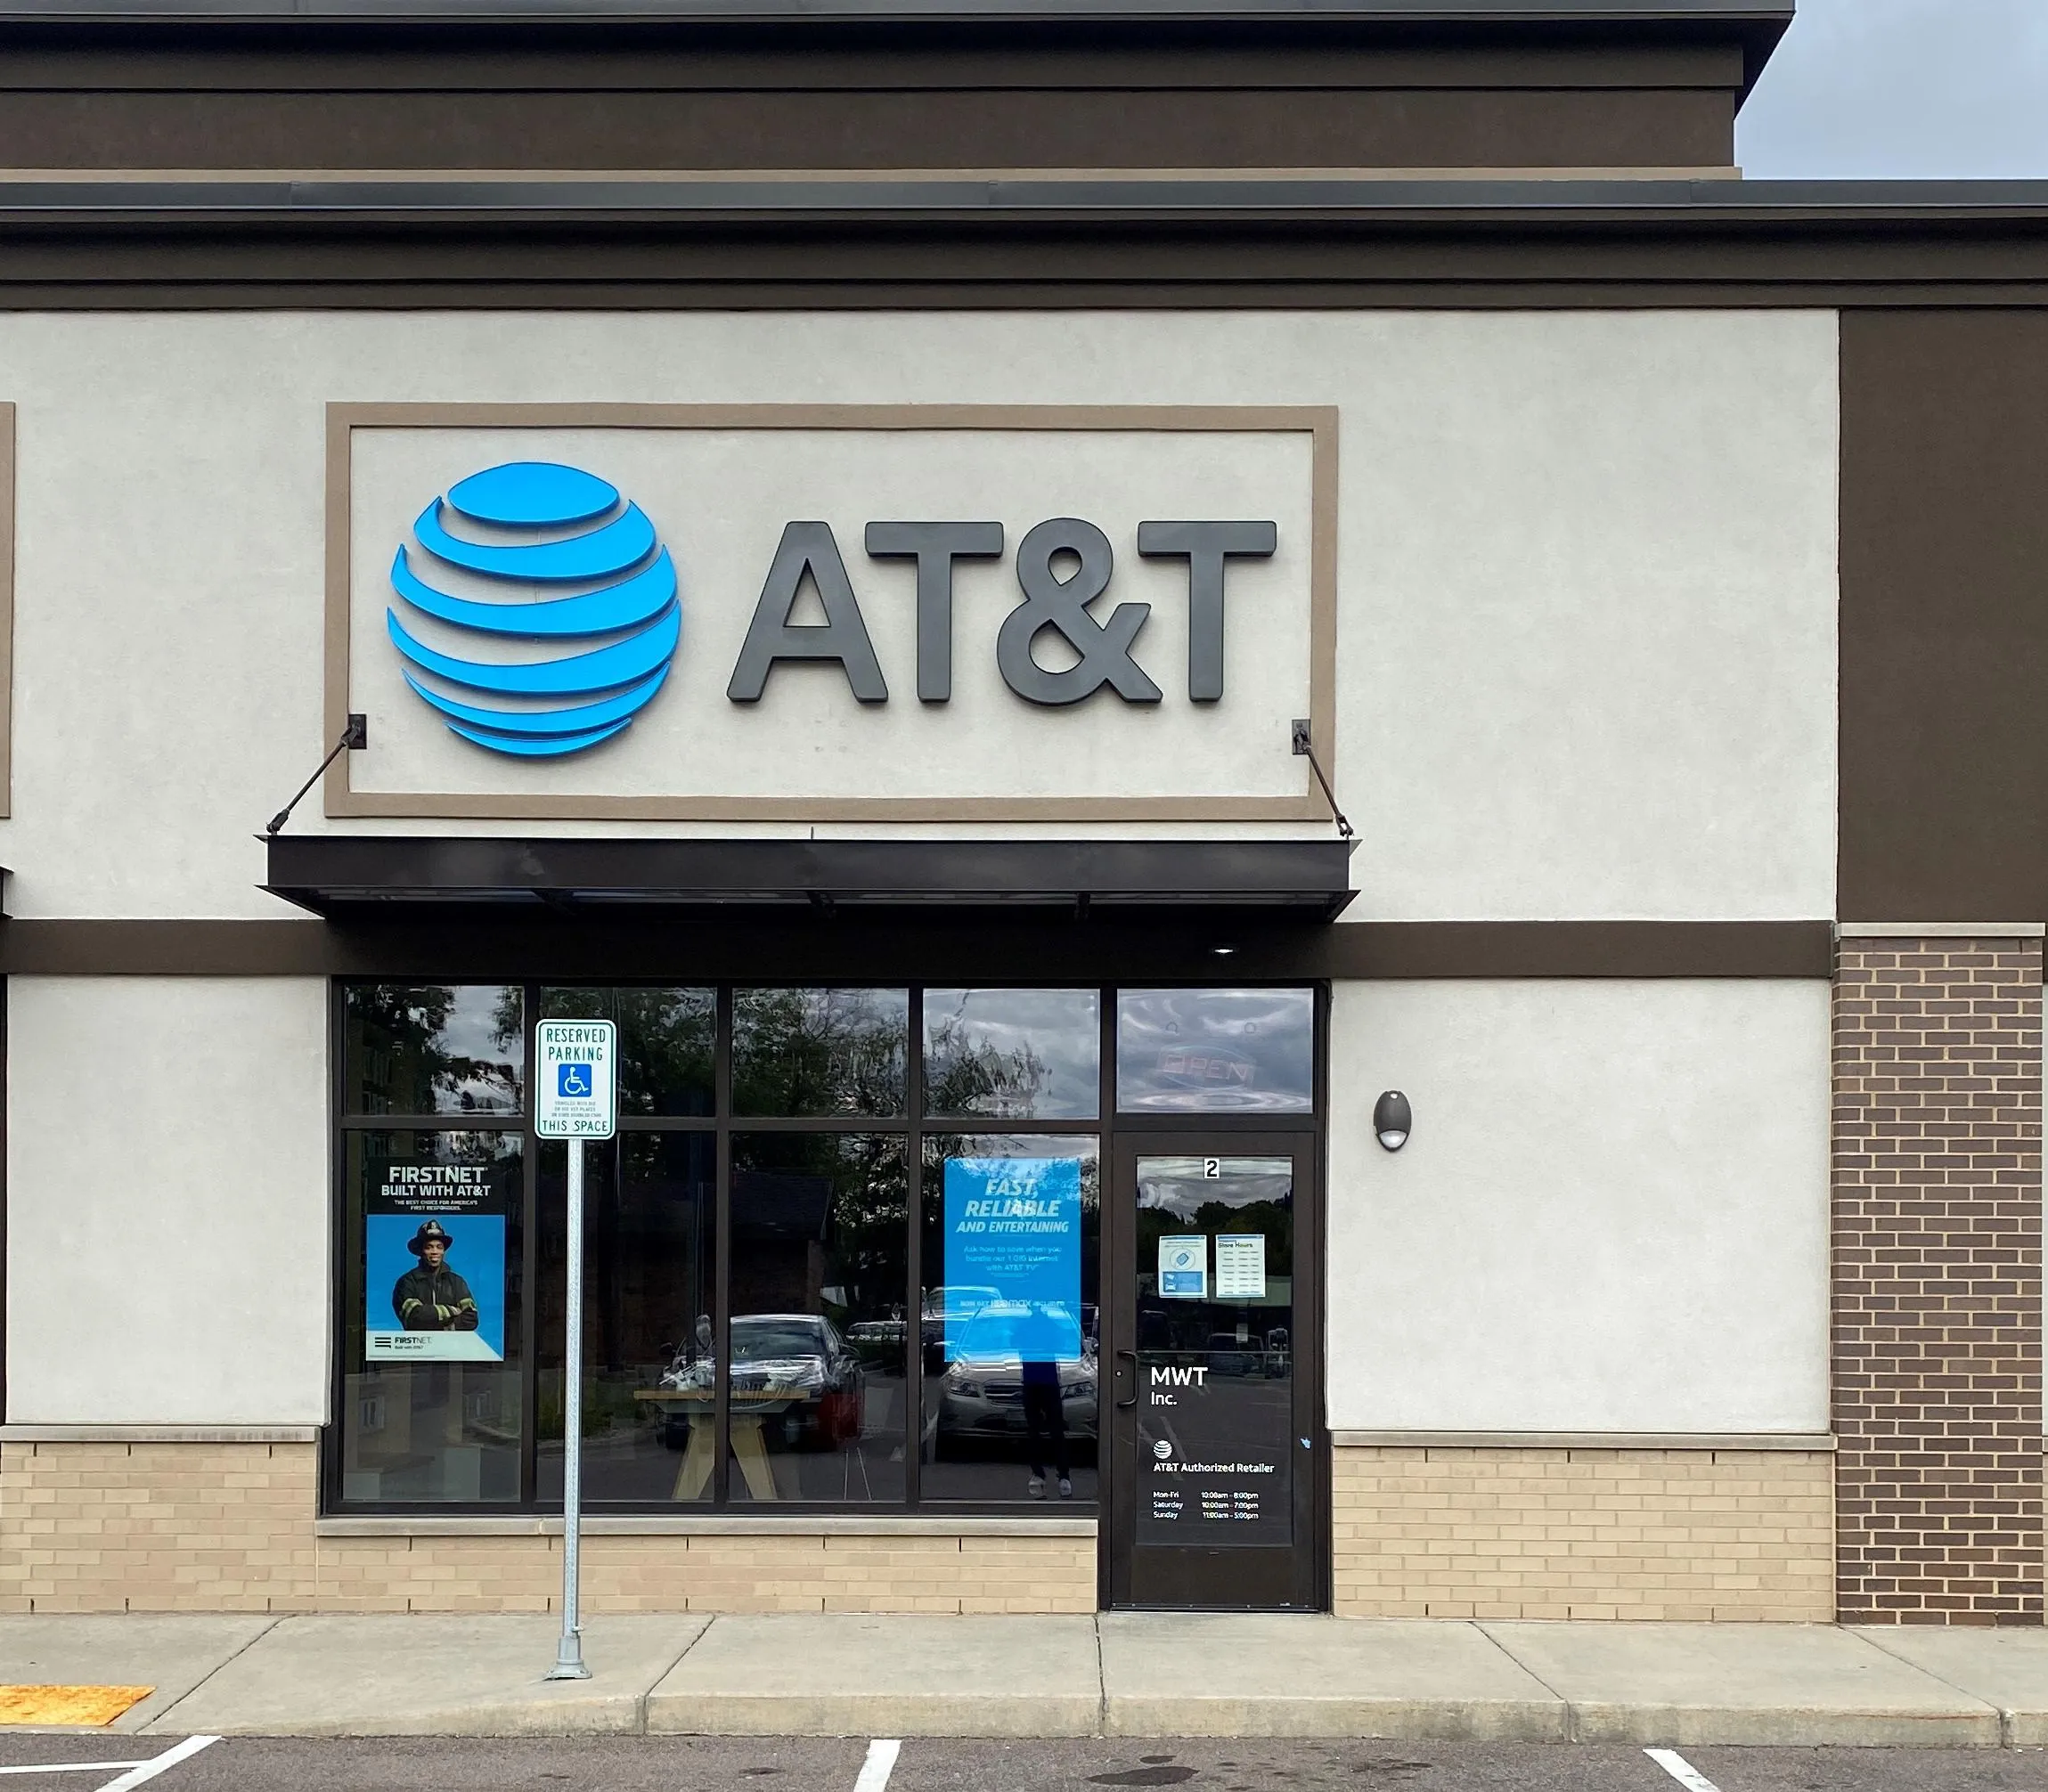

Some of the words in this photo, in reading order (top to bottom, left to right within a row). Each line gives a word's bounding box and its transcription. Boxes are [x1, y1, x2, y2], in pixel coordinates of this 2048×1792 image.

[726, 517, 1277, 706] AT&T
[546, 1028, 606, 1043] RESERVED
[548, 1047, 603, 1061] PARKING
[543, 1120, 567, 1132] THIS
[573, 1120, 608, 1132] SPACE
[388, 1166, 485, 1184] FIRSTNET
[1206, 1160, 1218, 1177] 2
[381, 1185, 417, 1196] BUILT
[419, 1185, 453, 1196] WITH
[456, 1185, 492, 1196] AT&T
[984, 1177, 1040, 1199] FAST,
[965, 1200, 1062, 1218] RELIABLE
[955, 1221, 986, 1234] AND
[988, 1221, 1070, 1234] ENTERTAINING
[979, 1245, 996, 1253] how
[1025, 1245, 1046, 1253] when
[986, 1264, 1003, 1272] with
[1004, 1264, 1024, 1272] AT&T
[395, 1336, 432, 1344] FIRSTNET
[1151, 1366, 1208, 1387] MWT
[1151, 1391, 1178, 1405] Inc.
[1153, 1462, 1179, 1472] AT&T
[1180, 1462, 1235, 1472] Authorized
[1236, 1463, 1275, 1473] Retailer
[1153, 1501, 1184, 1510] Saturday
[1234, 1502, 1259, 1511] 7:00pm
[1153, 1511, 1179, 1520] Sunday
